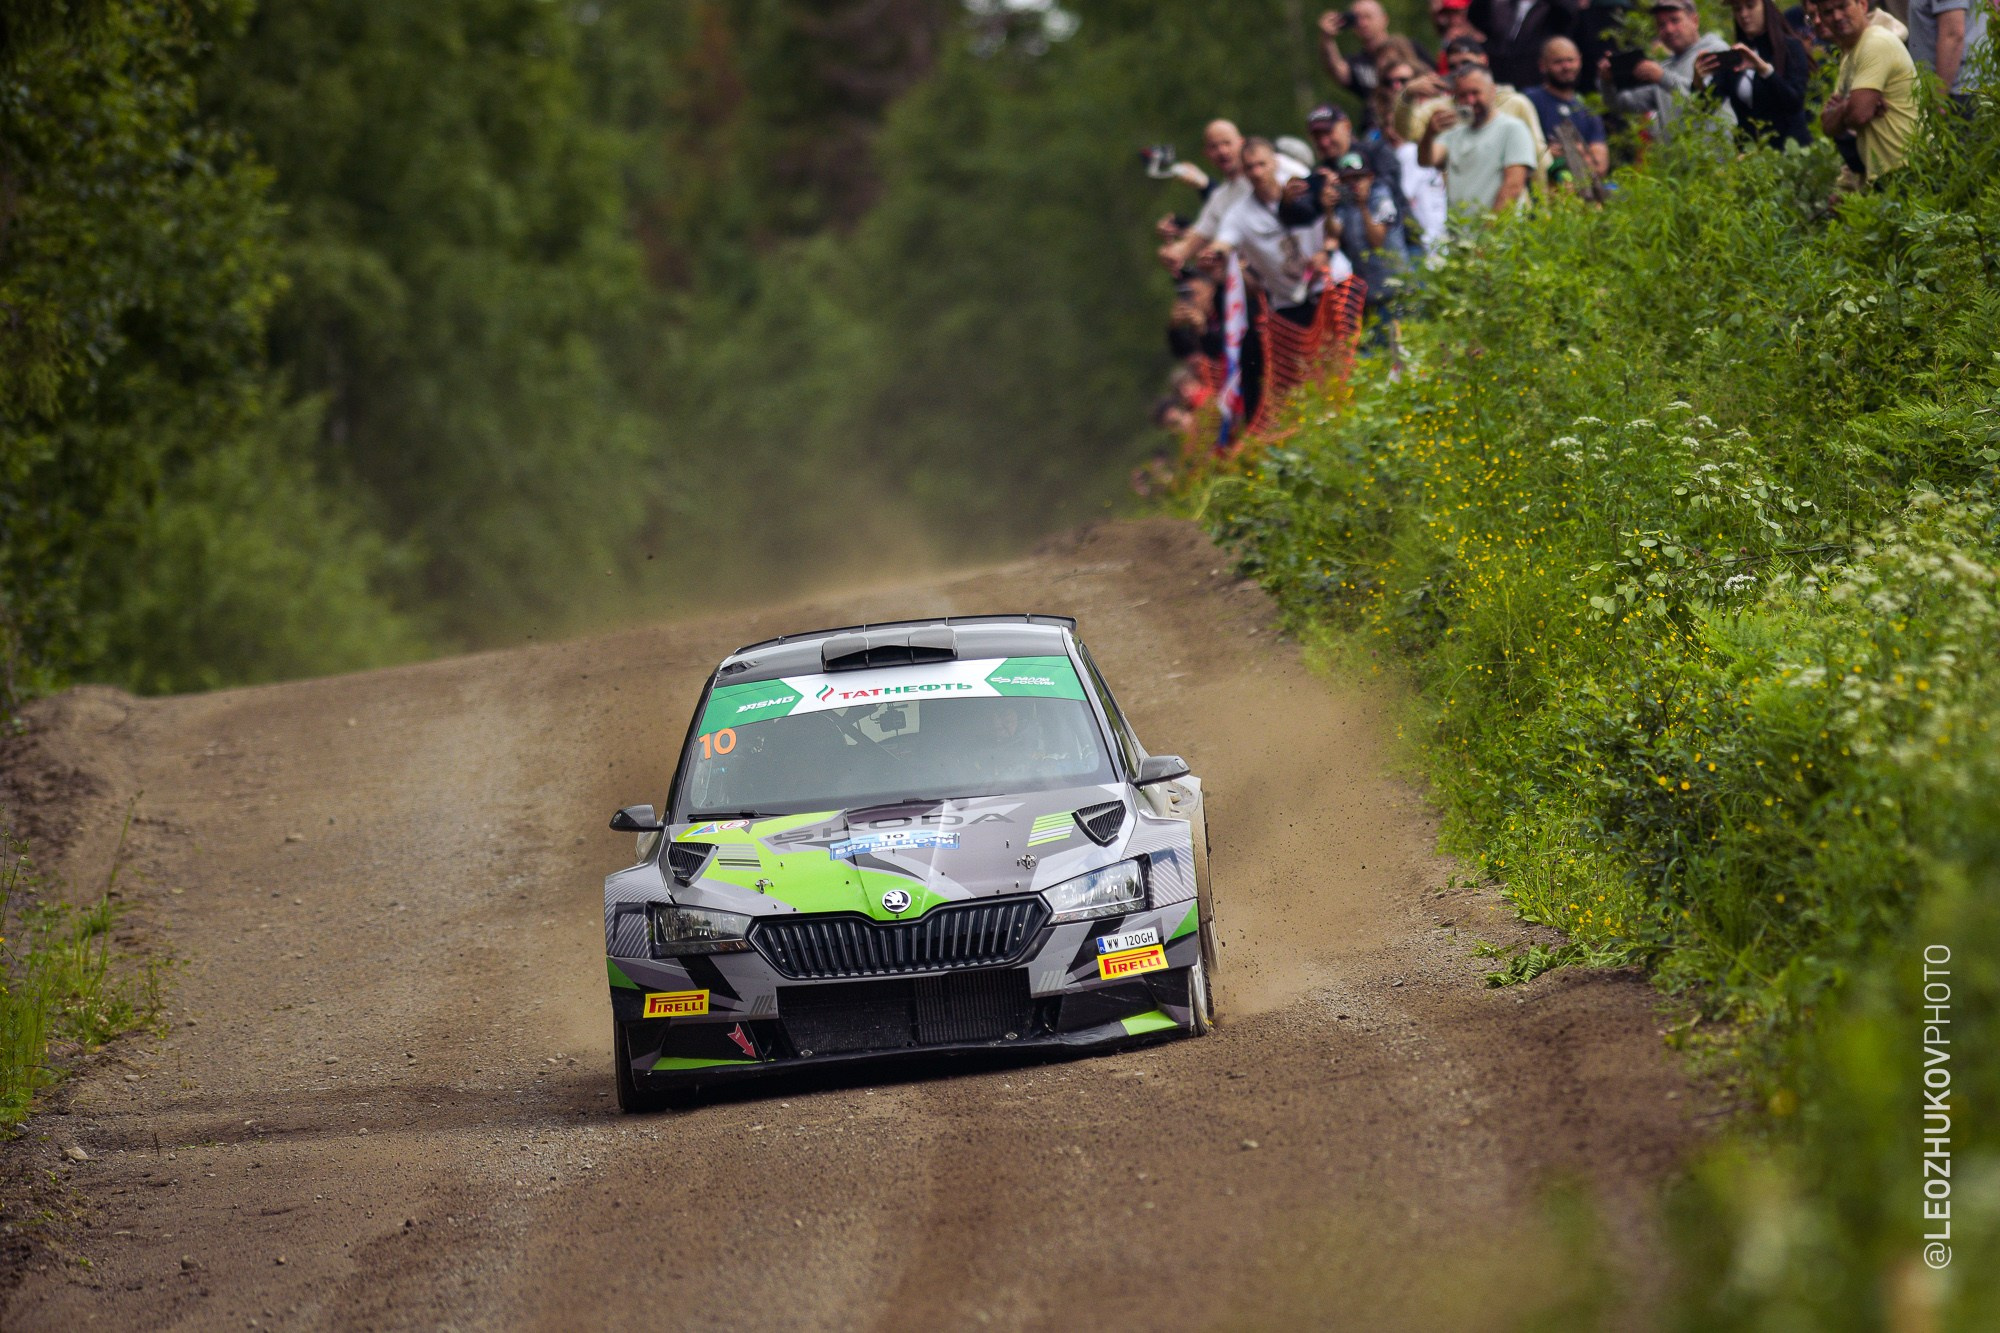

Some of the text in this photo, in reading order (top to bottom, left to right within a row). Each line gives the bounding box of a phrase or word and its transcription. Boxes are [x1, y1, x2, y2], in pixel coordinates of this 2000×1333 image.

[838, 682, 973, 700] ТАТНЕФТЬ
[698, 727, 737, 760] 10
[901, 836, 955, 846] НОЧИ
[1106, 932, 1154, 950] WW 120GH
[1103, 950, 1161, 975] PIRELLI
[649, 994, 704, 1012] PIRELLI
